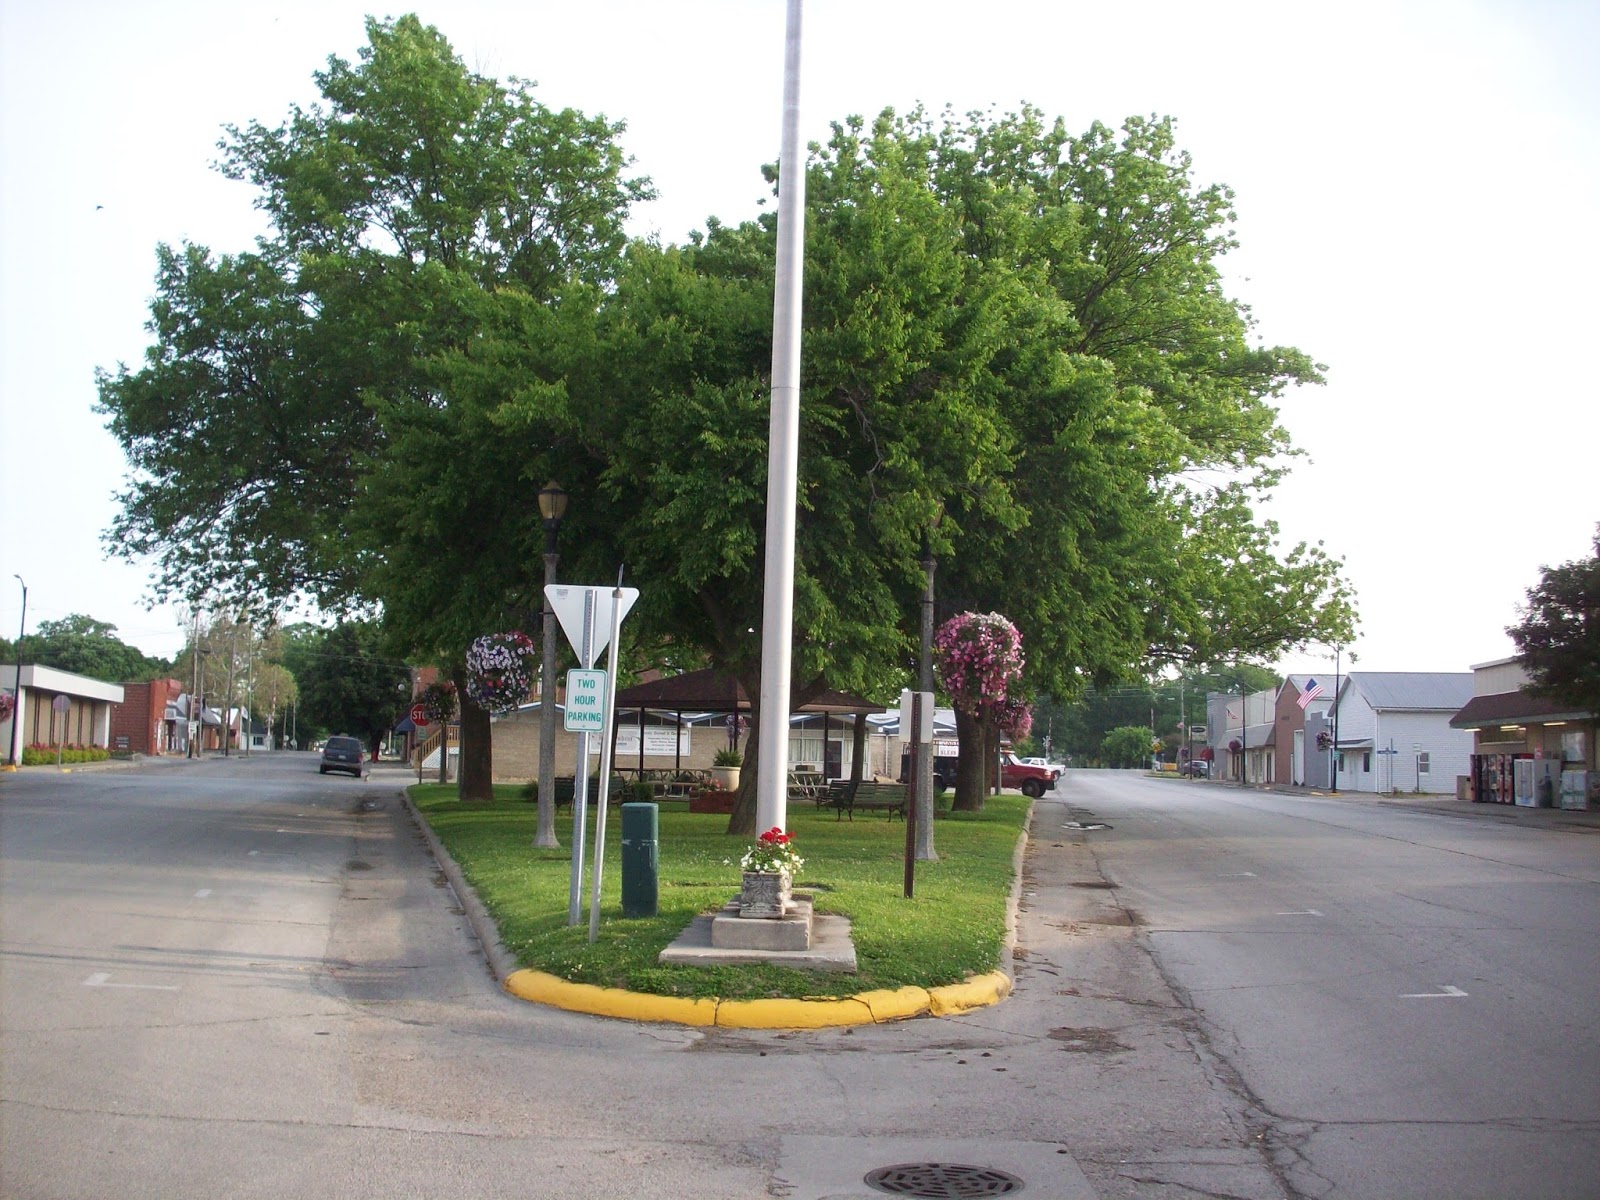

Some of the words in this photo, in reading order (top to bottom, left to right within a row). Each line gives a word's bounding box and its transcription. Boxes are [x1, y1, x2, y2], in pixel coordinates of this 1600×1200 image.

[578, 678, 596, 688] TWO
[574, 696, 596, 705] HOUR
[568, 712, 602, 722] PARKING
